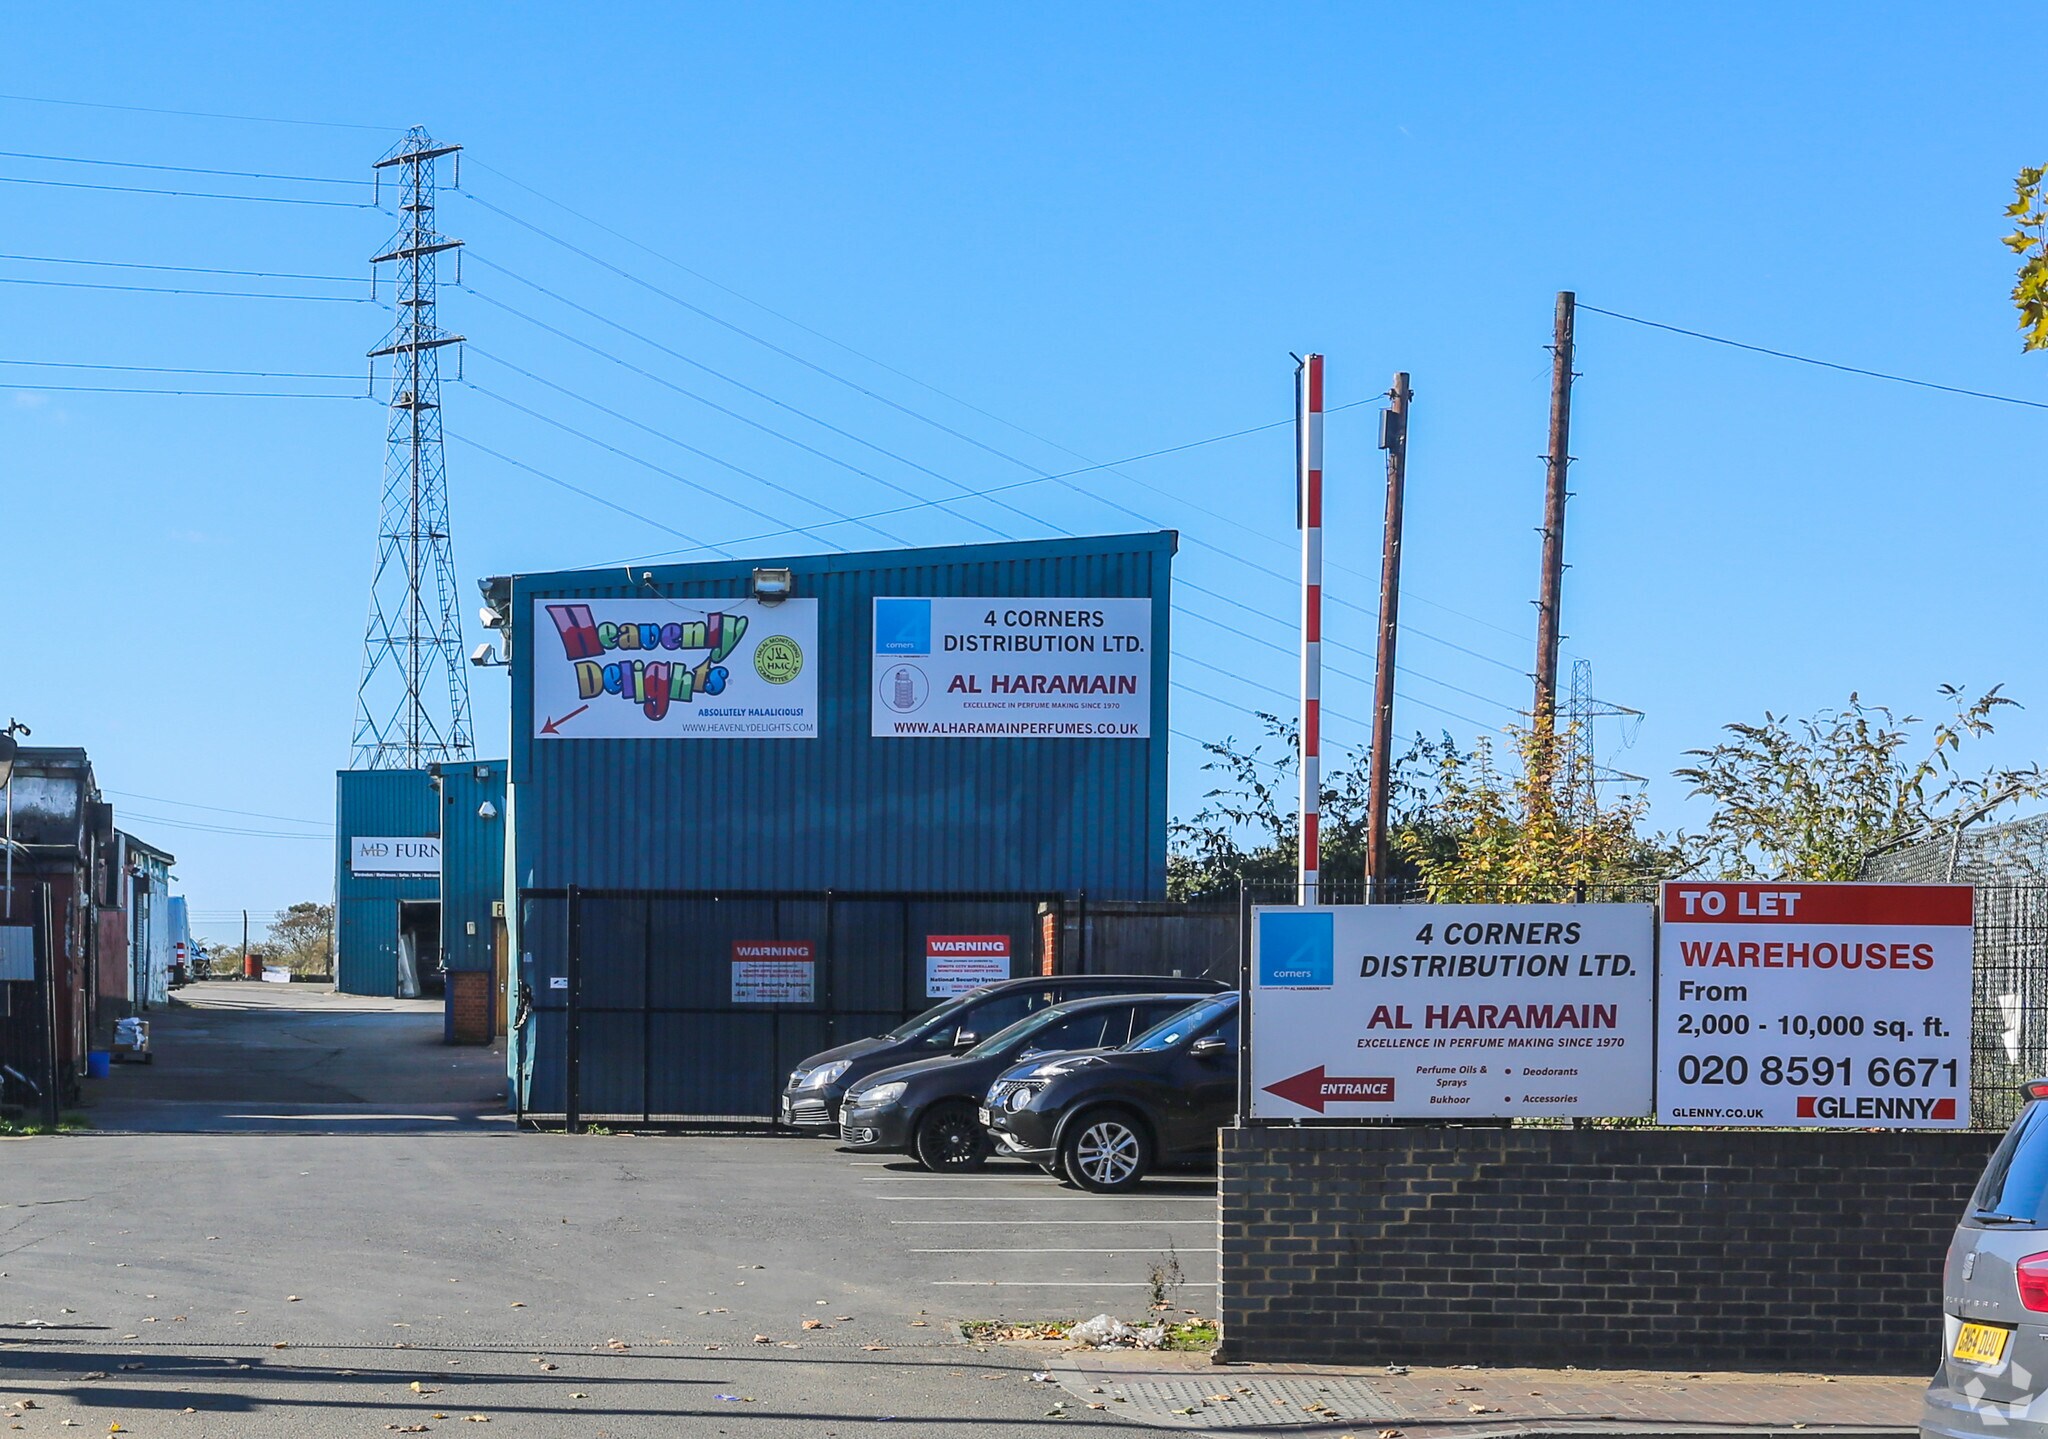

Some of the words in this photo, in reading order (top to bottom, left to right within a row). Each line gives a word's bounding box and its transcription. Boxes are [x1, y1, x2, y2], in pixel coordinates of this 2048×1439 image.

[983, 610, 997, 627] 4
[1003, 610, 1104, 628] CORNERS
[544, 604, 749, 664] Heavenly
[944, 634, 1095, 652] DISTRIBUTION
[1103, 635, 1144, 653] LTD.
[767, 662, 790, 670] HMC
[574, 659, 729, 721] Delights
[946, 674, 982, 694] AL
[991, 674, 1137, 695] HARAMAIN
[963, 701, 1007, 709] EXCELLENCE
[1103, 702, 1121, 710] 1970
[698, 708, 747, 717] ABSOLUTELY
[748, 708, 804, 717] HALALICIOUS!
[682, 722, 814, 732] WWW.HEAVENLYDELIGHTS.COM
[893, 722, 1139, 735] WWW.ALHARAMAINPERFUMES.CO.UK
[1679, 890, 1726, 916] TO
[1738, 891, 1802, 916] LET
[1415, 923, 1434, 945] 4
[1443, 922, 1582, 946] CORNERS
[736, 946, 809, 957] WARNING
[931, 941, 1005, 952] WARNING
[1679, 941, 1934, 970] WAREHOUSES
[1359, 954, 1569, 978] DISTRIBUTION
[1578, 954, 1636, 977] LTD.
[1679, 980, 1747, 1002] From
[1366, 1005, 1413, 1030] AL
[1424, 1004, 1618, 1029] HARAMAIN
[1677, 1013, 1750, 1039] 2,000
[1777, 1015, 1865, 1040] 10,000
[1873, 1020, 1914, 1042] sq.
[1922, 1016, 1950, 1037] ft.
[1357, 1038, 1431, 1048] EXCELLENCE
[1433, 1038, 1447, 1048] IN
[1449, 1038, 1505, 1048] PERFUME
[1507, 1037, 1554, 1048] MAKING
[1557, 1037, 1594, 1048] SINCE
[1596, 1037, 1625, 1048] 1970
[1416, 1065, 1457, 1074] Perfume
[1458, 1065, 1478, 1074] Oils
[1479, 1065, 1488, 1074] &
[1522, 1067, 1578, 1076] Deodorants
[1678, 1054, 1749, 1086] 020
[1760, 1055, 1851, 1087] 8591
[1867, 1057, 1957, 1088] 6671
[1320, 1083, 1388, 1095] ENTRANCE
[1436, 1078, 1467, 1089] Sprays
[1429, 1095, 1471, 1104] Bukhoor
[1522, 1094, 1578, 1103] Accessories
[1672, 1108, 1764, 1119] GLENNY.CO.UK
[1816, 1096, 1935, 1119] GLENNY
